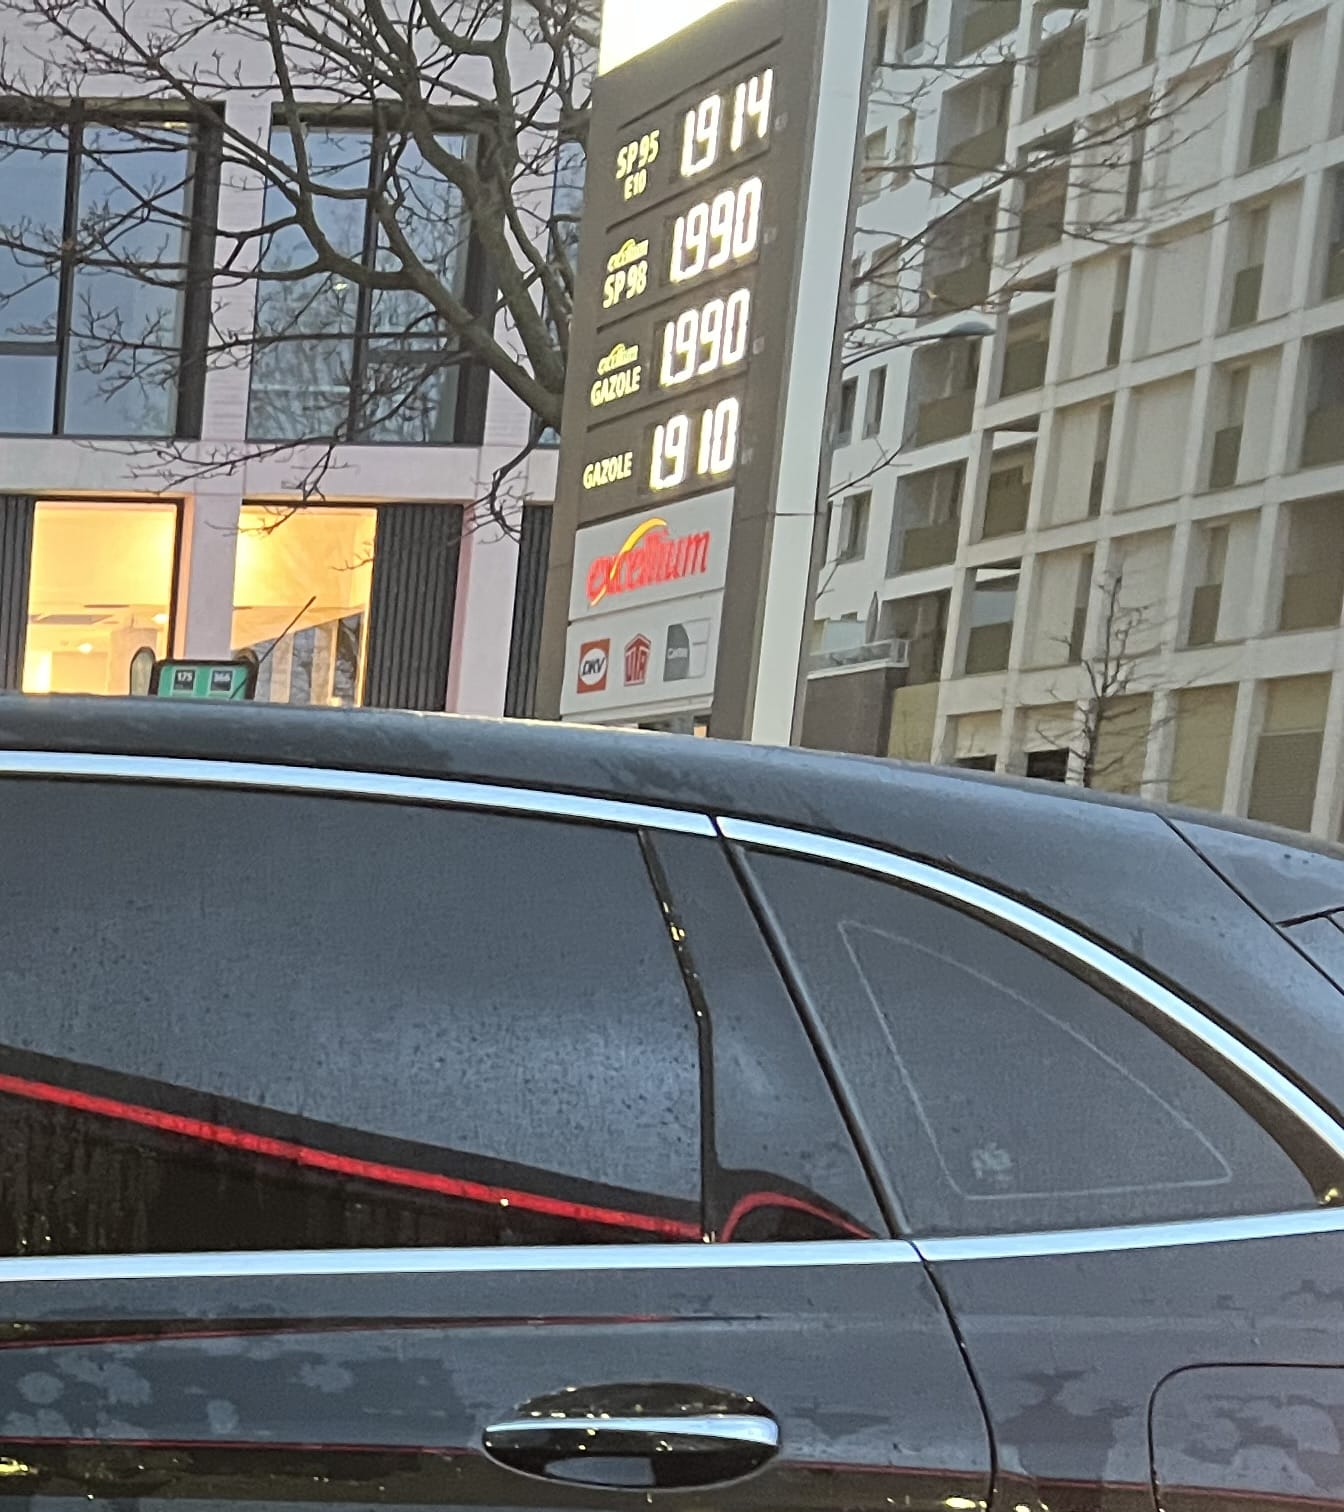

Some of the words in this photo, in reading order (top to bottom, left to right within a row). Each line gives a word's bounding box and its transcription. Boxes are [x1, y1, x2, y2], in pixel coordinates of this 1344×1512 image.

[624, 169, 647, 200] E10
[591, 365, 641, 407] GAZOLE
[583, 452, 633, 489] GAZOLE
[582, 657, 606, 677] DKV
